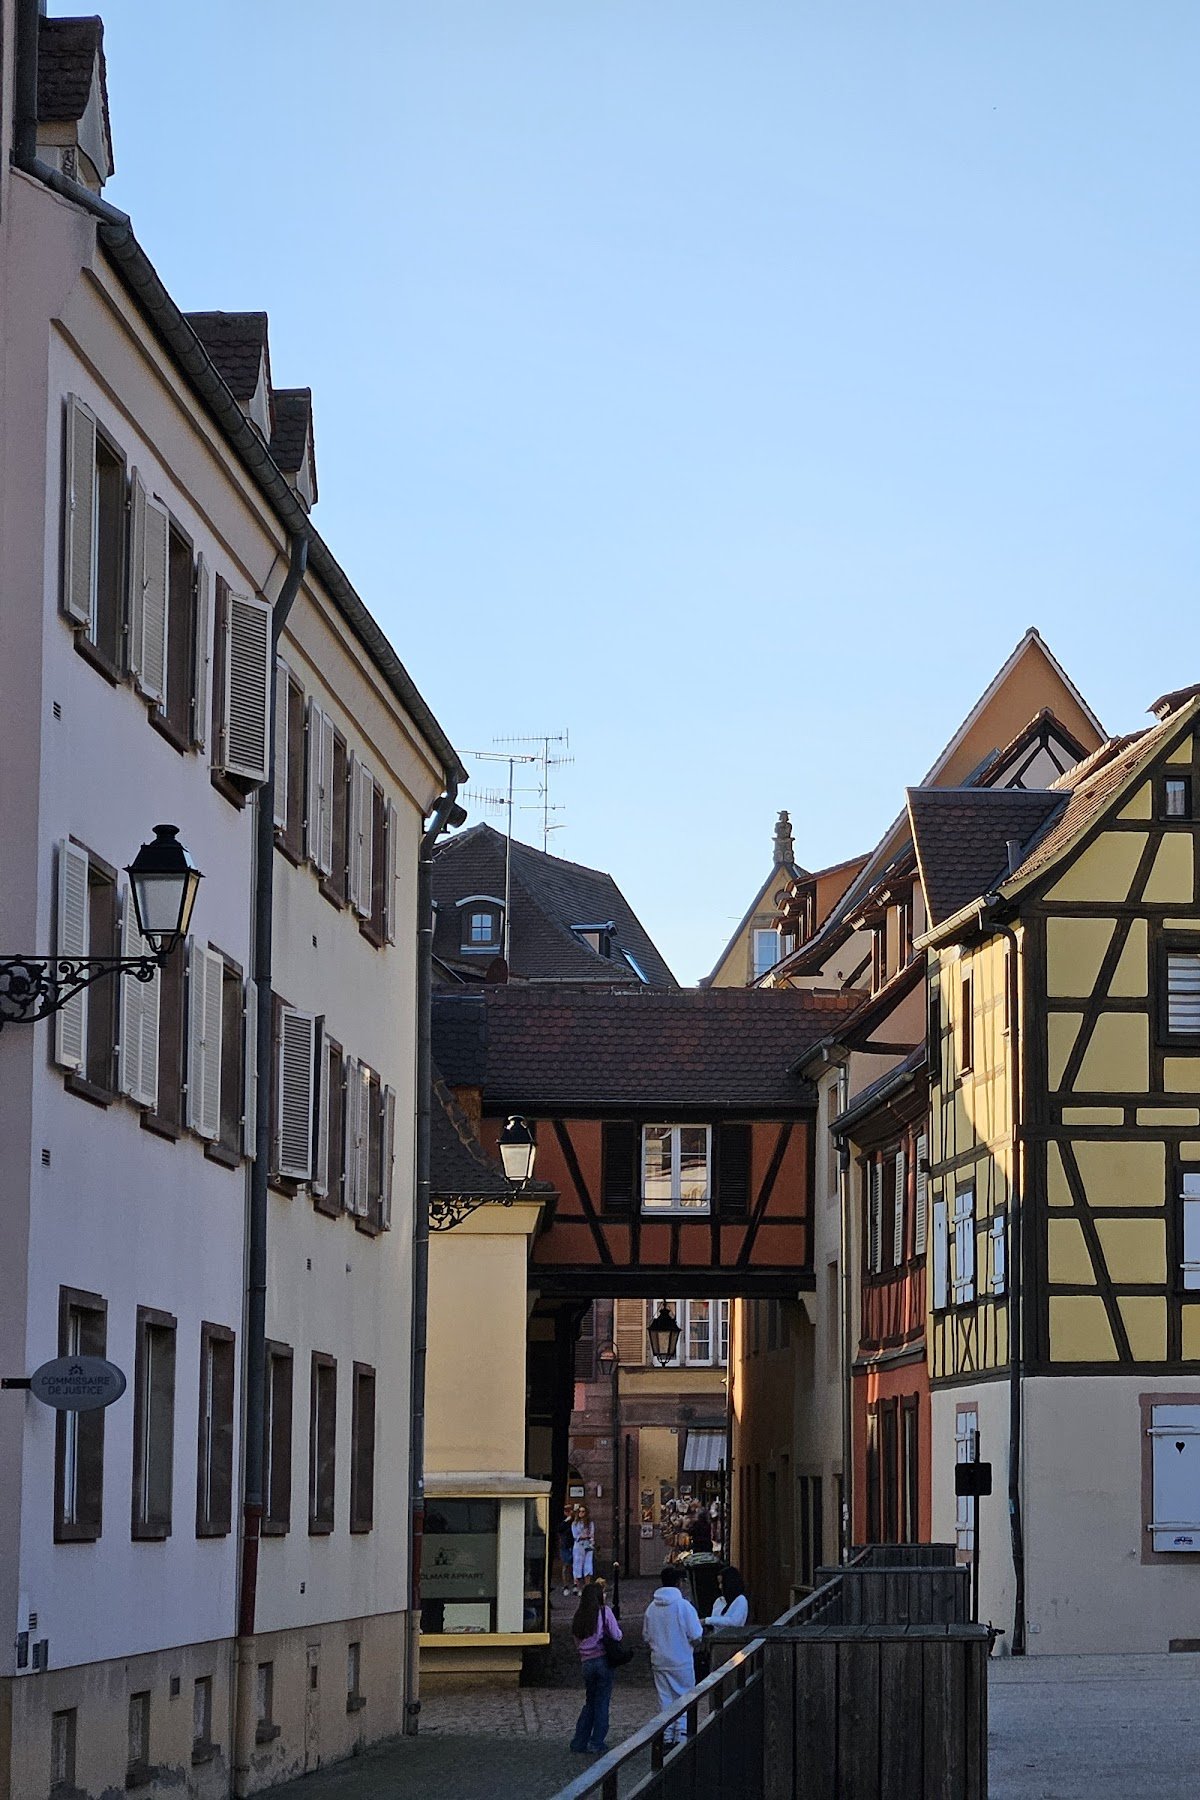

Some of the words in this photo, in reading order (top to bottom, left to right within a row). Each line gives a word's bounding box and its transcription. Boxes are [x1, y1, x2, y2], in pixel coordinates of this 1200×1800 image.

[41, 1376, 110, 1385] COMMISSAIRE
[48, 1385, 61, 1395] DE
[63, 1385, 103, 1395] JUSTICE
